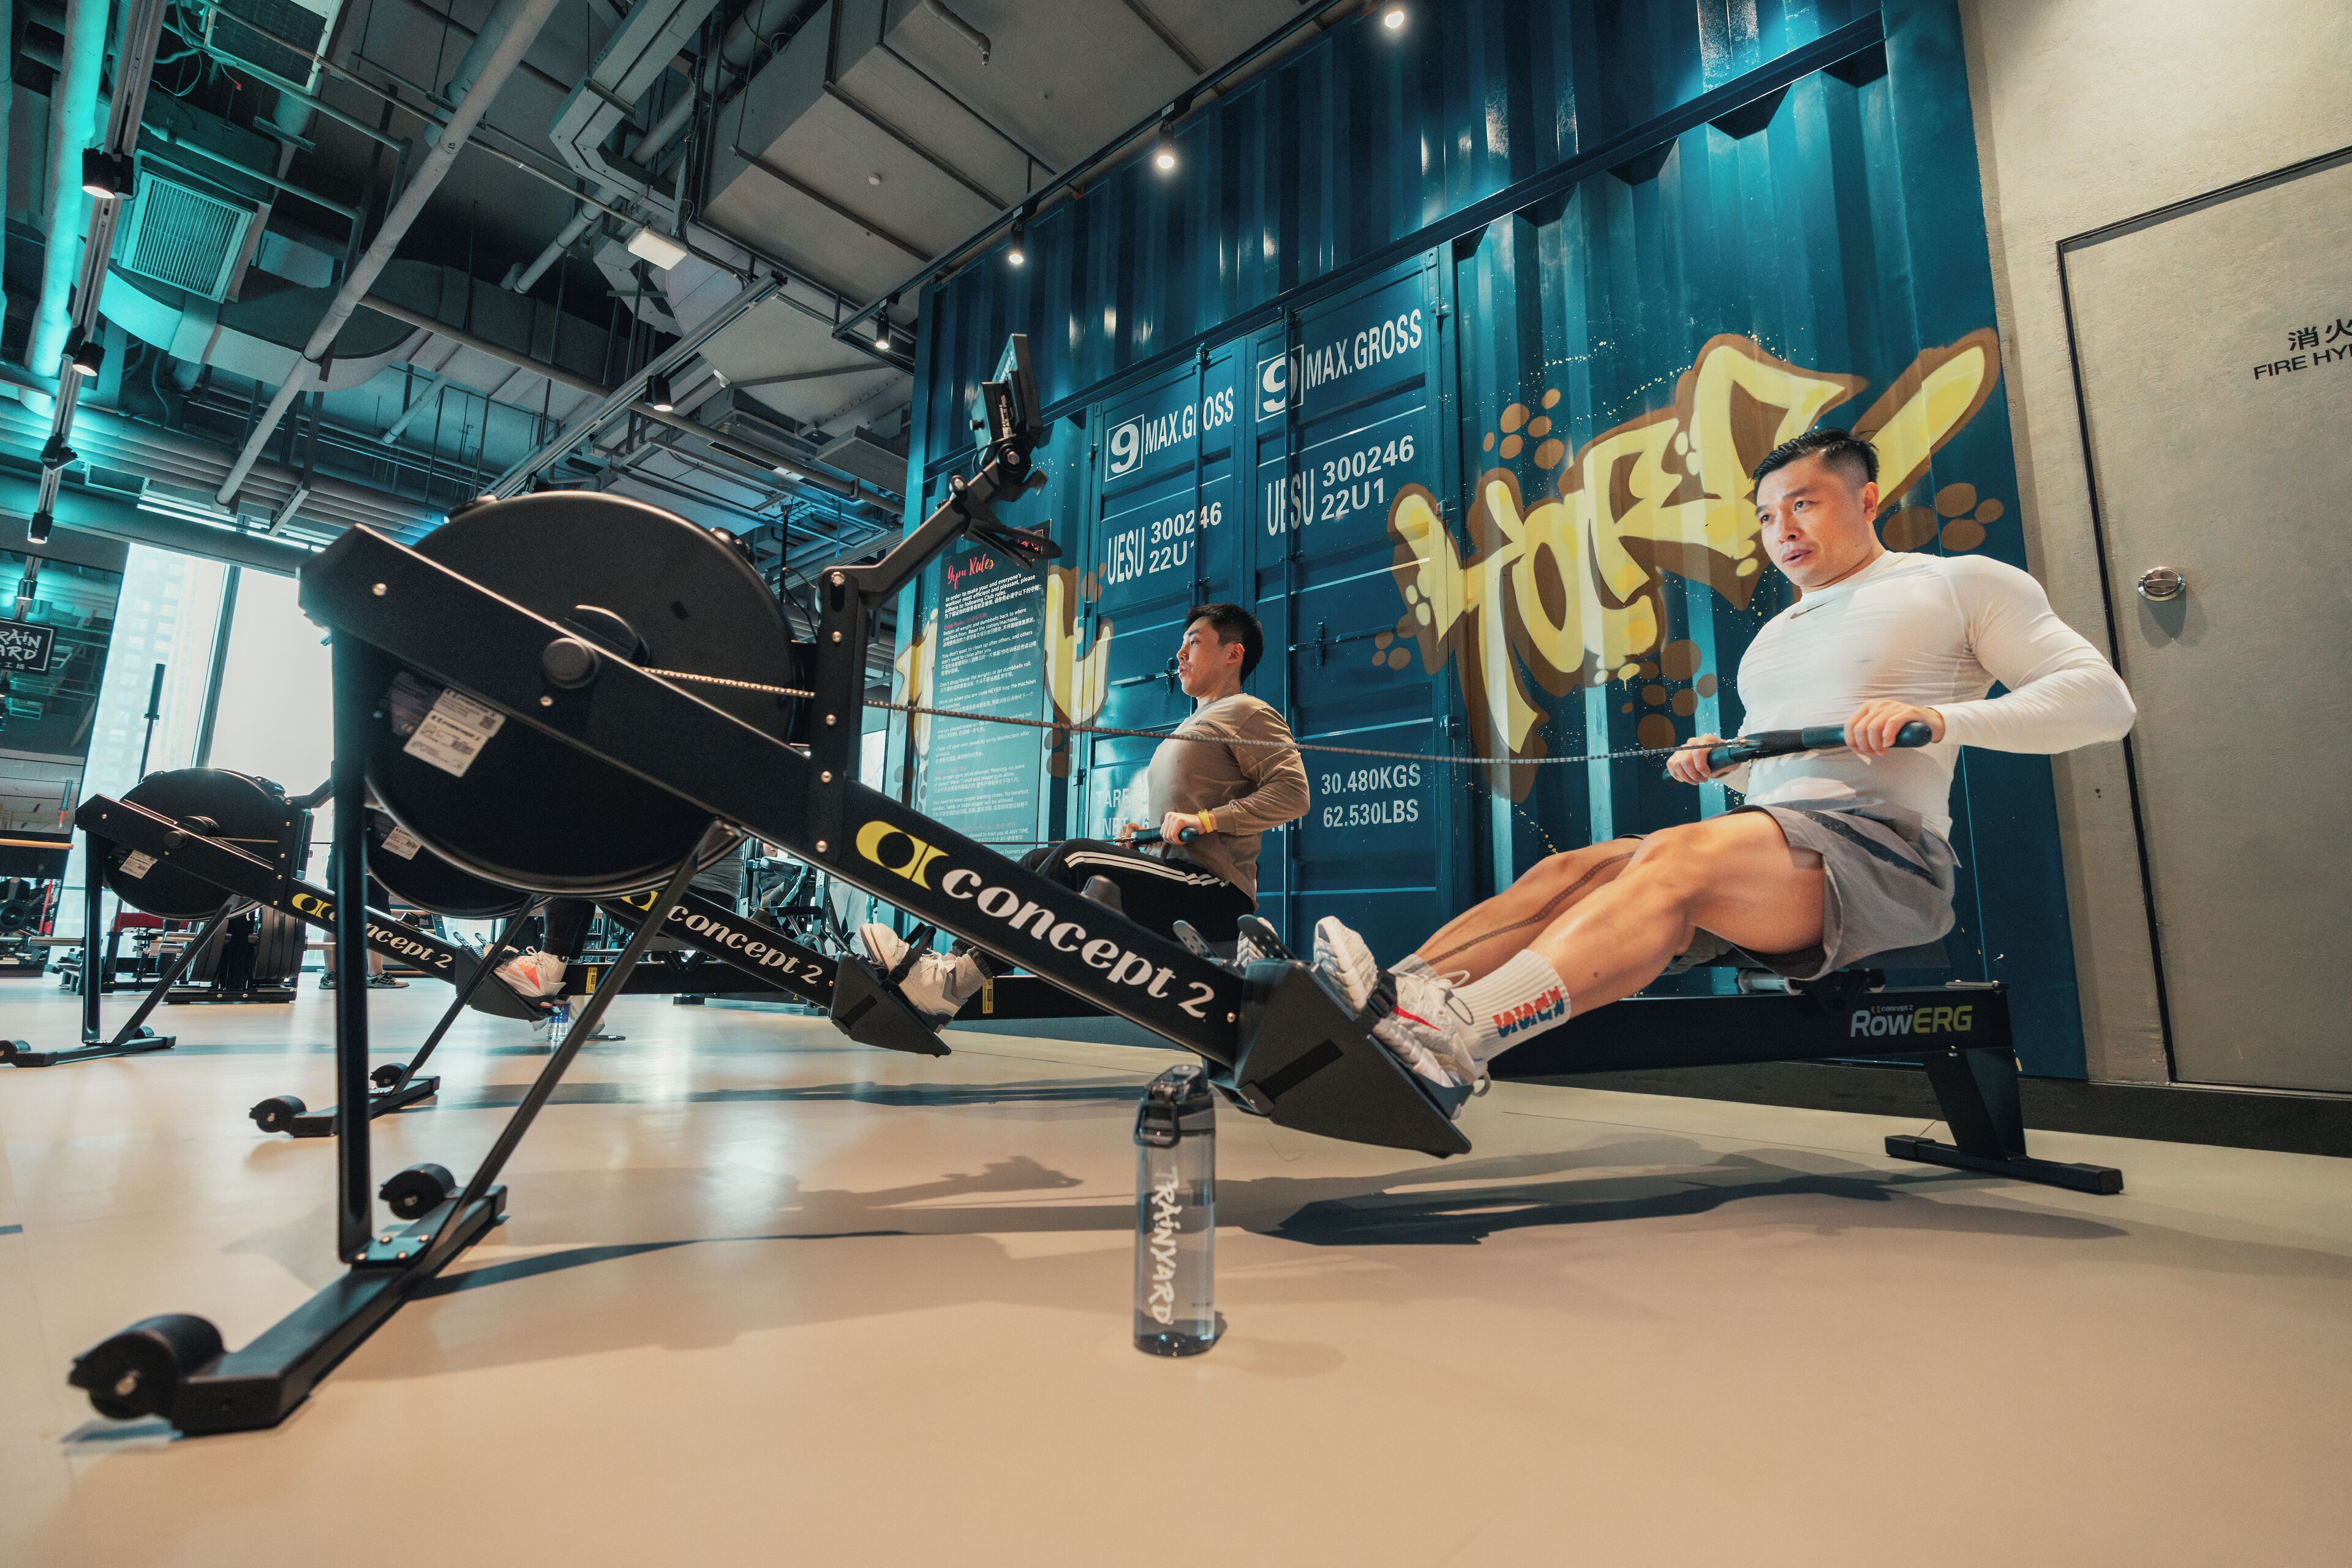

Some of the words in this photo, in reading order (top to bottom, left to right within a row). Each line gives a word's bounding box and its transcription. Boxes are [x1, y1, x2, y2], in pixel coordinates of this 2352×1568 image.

[1262, 357, 1297, 413] 9
[1306, 309, 1421, 390] MAX.GROSS
[2253, 355, 2308, 380] FIRE
[1110, 423, 1139, 473] 9
[1268, 468, 1314, 537] UESU
[1322, 435, 1414, 488] 300246
[1321, 478, 1384, 521] 22U1
[1108, 527, 1145, 586] UESU
[1151, 502, 1222, 545] 300246
[948, 565, 967, 590] Gym
[970, 553, 994, 576] Rules
[945, 598, 961, 608] workout
[973, 589, 989, 598] efficient
[1020, 575, 1035, 584] please
[964, 597, 983, 608] following
[980, 616, 998, 625] dumbbells
[1321, 763, 1420, 795] 30.480KGS
[1324, 799, 1419, 827] 62.530LBS
[434, 954, 453, 968] 2
[667, 905, 801, 973] concept
[801, 964, 823, 984] 2
[941, 869, 1177, 999] concept
[1178, 981, 1215, 1018] 2
